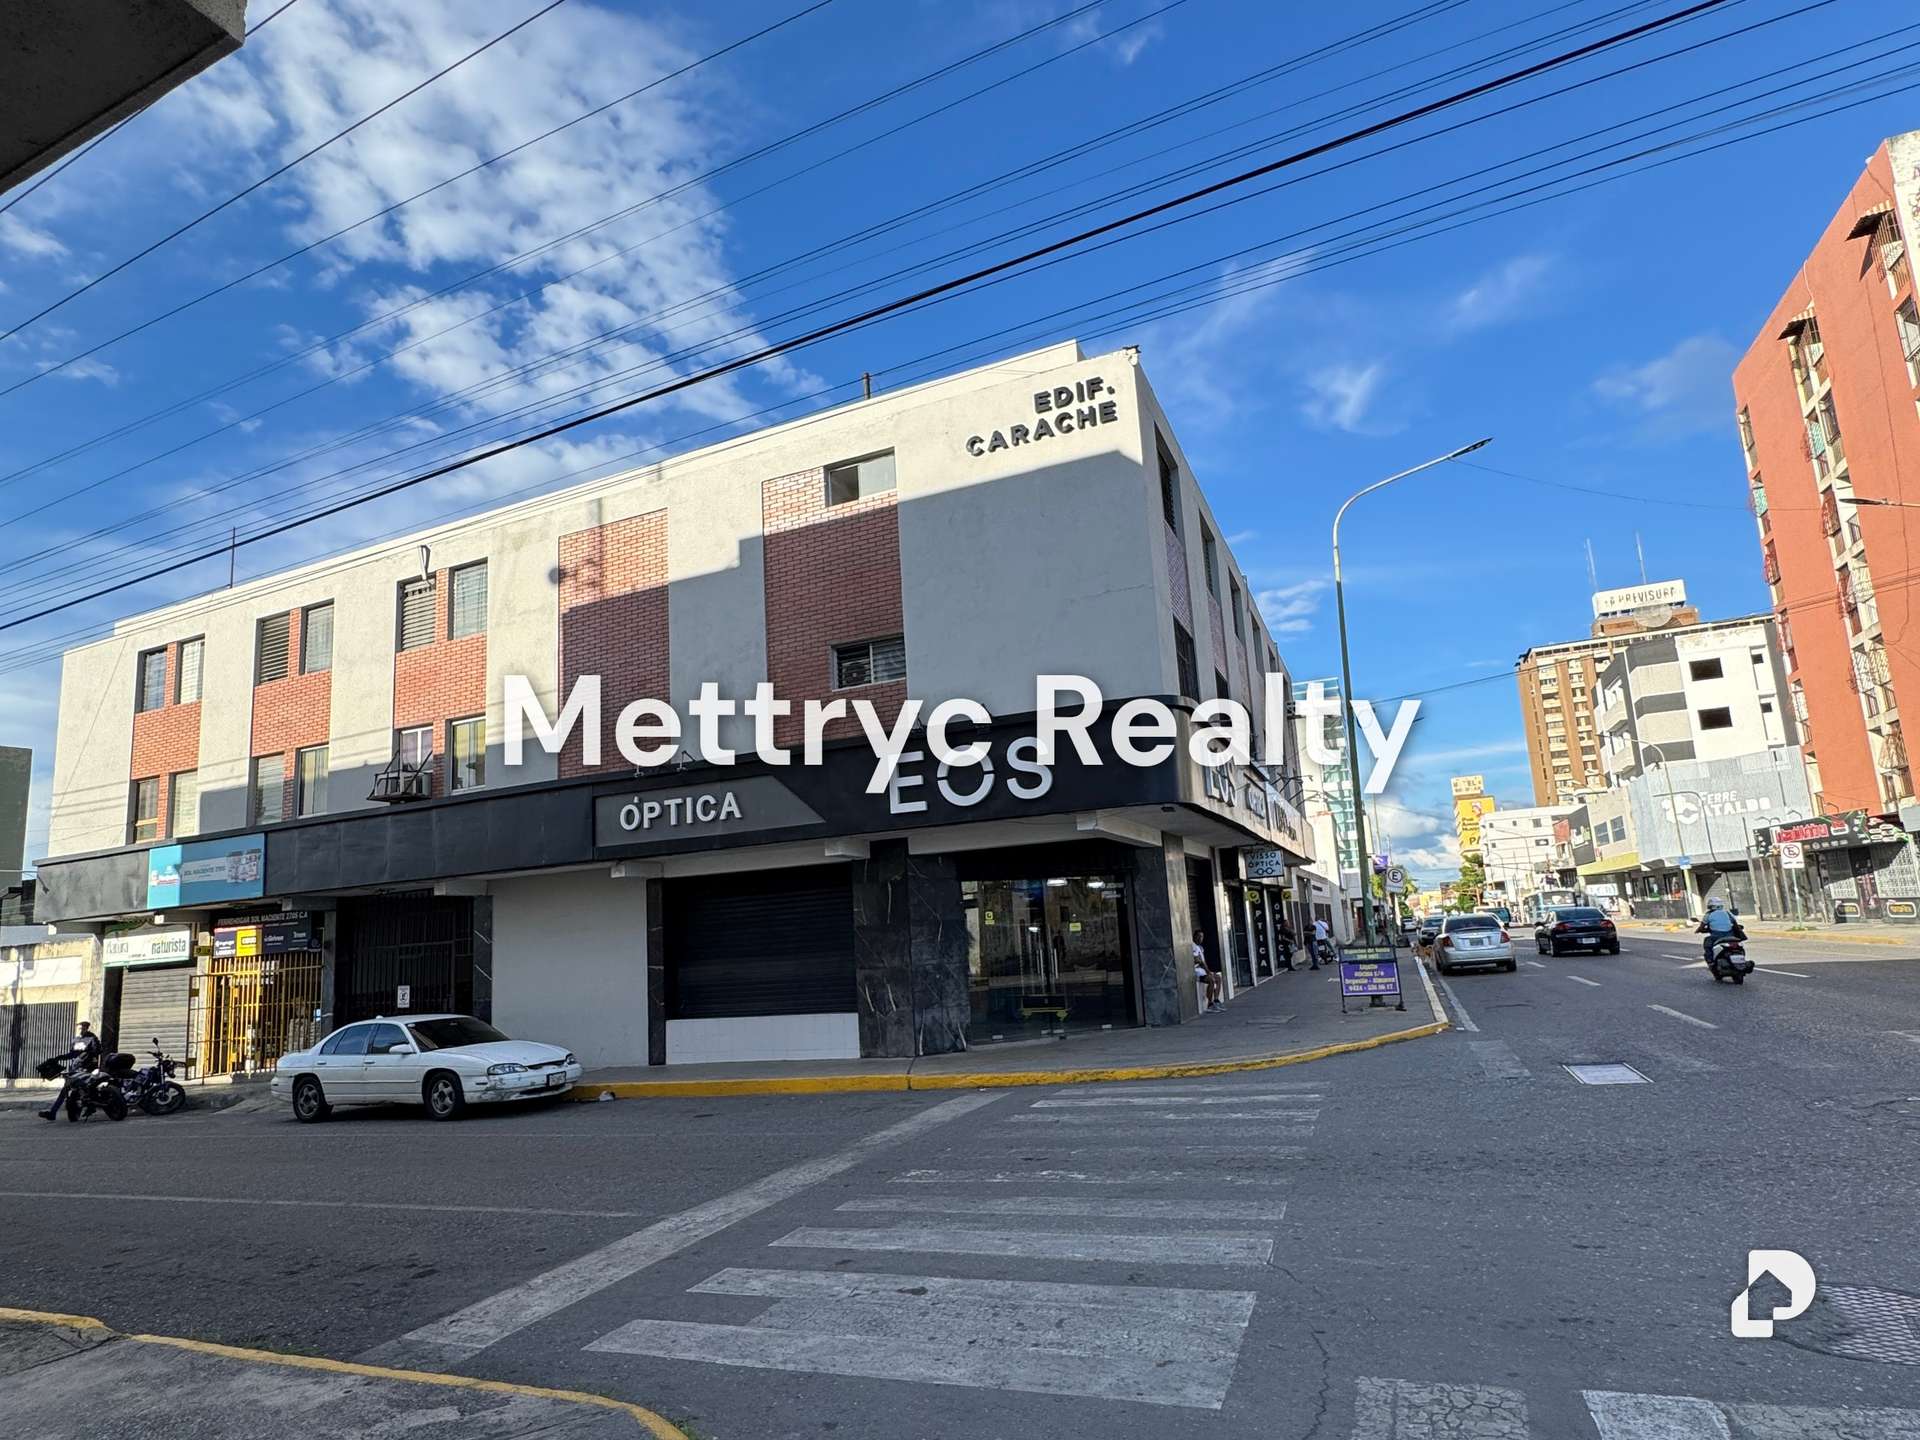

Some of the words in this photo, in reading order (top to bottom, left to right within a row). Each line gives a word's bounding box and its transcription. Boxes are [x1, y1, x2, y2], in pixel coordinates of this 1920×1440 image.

[1033, 376, 1116, 414] EDIF.
[965, 400, 1119, 457] CARACHE
[888, 735, 1054, 816] EOS
[618, 791, 742, 832] ÓPTICA
[1392, 871, 1399, 881] E
[151, 936, 187, 955] naturista
